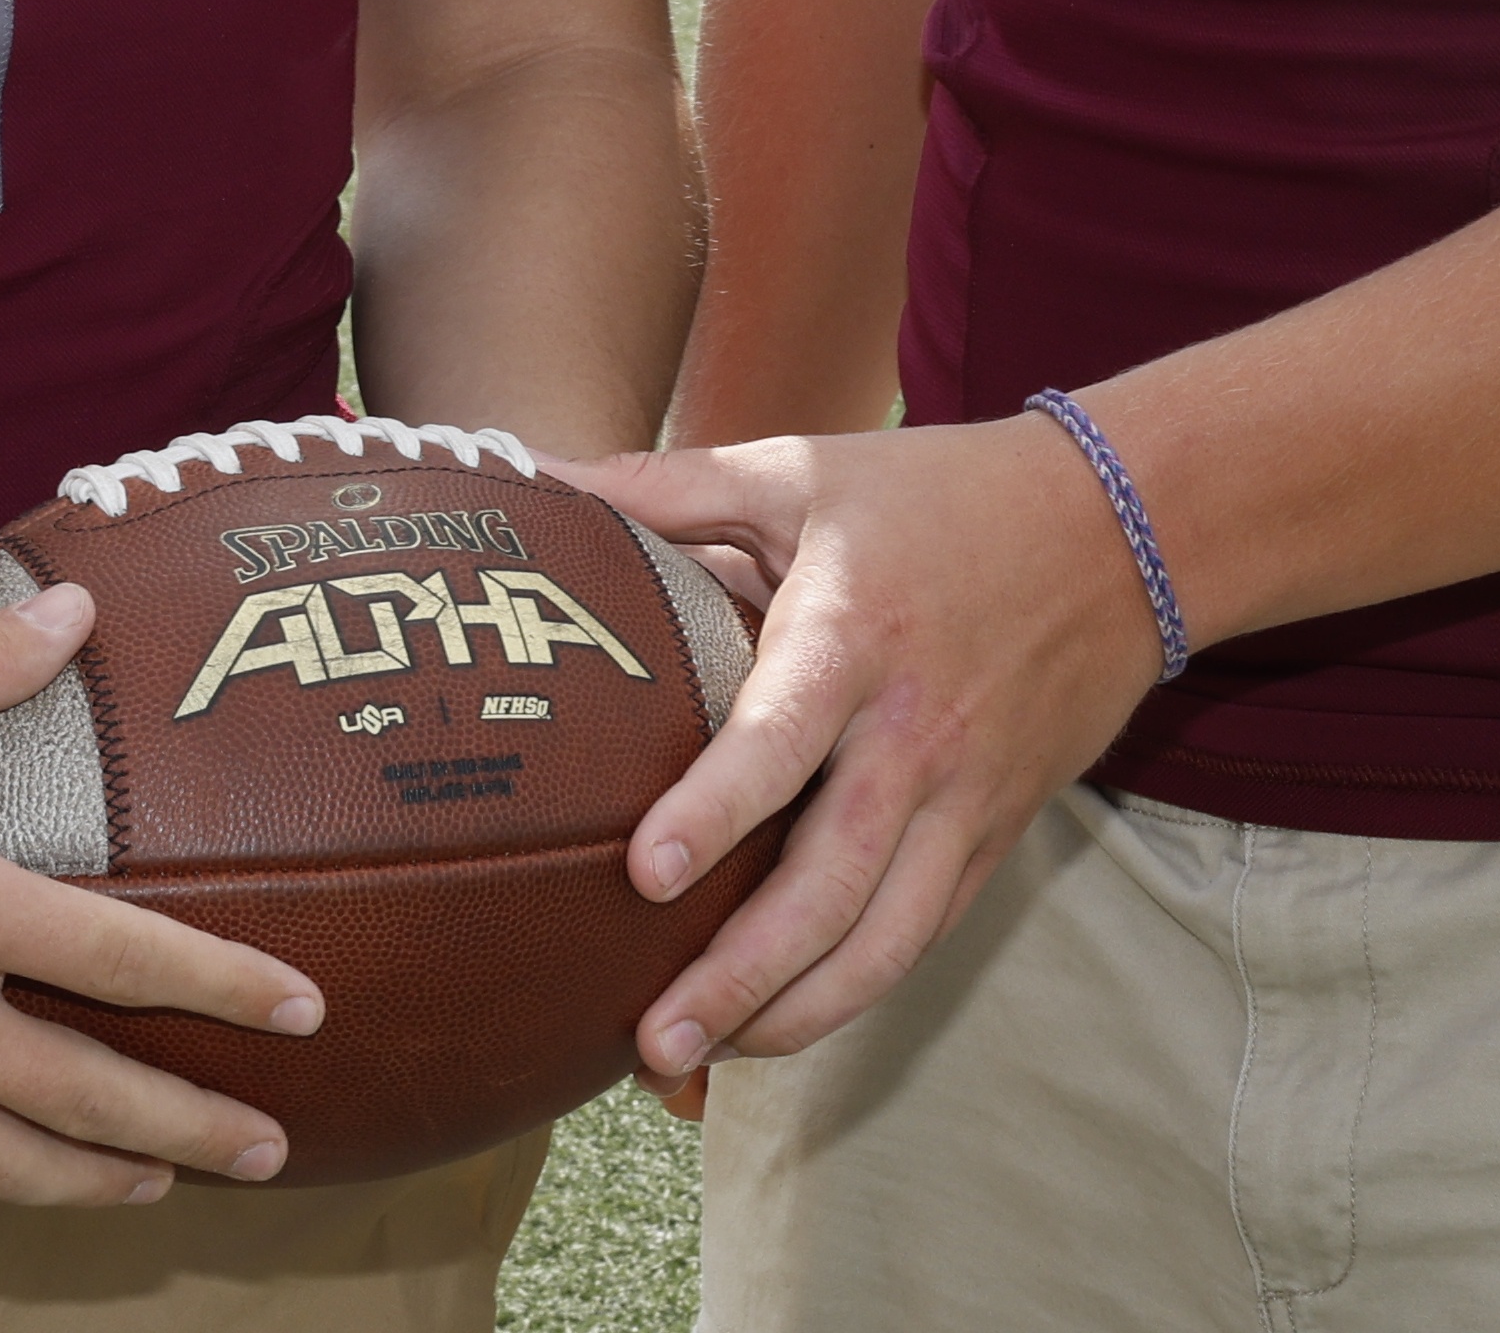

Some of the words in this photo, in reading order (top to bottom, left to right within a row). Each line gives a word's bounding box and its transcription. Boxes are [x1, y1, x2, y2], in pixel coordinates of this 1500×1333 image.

[221, 509, 529, 584] SPALDING
[173, 569, 654, 720] ALPHA
[339, 704, 405, 735] USA
